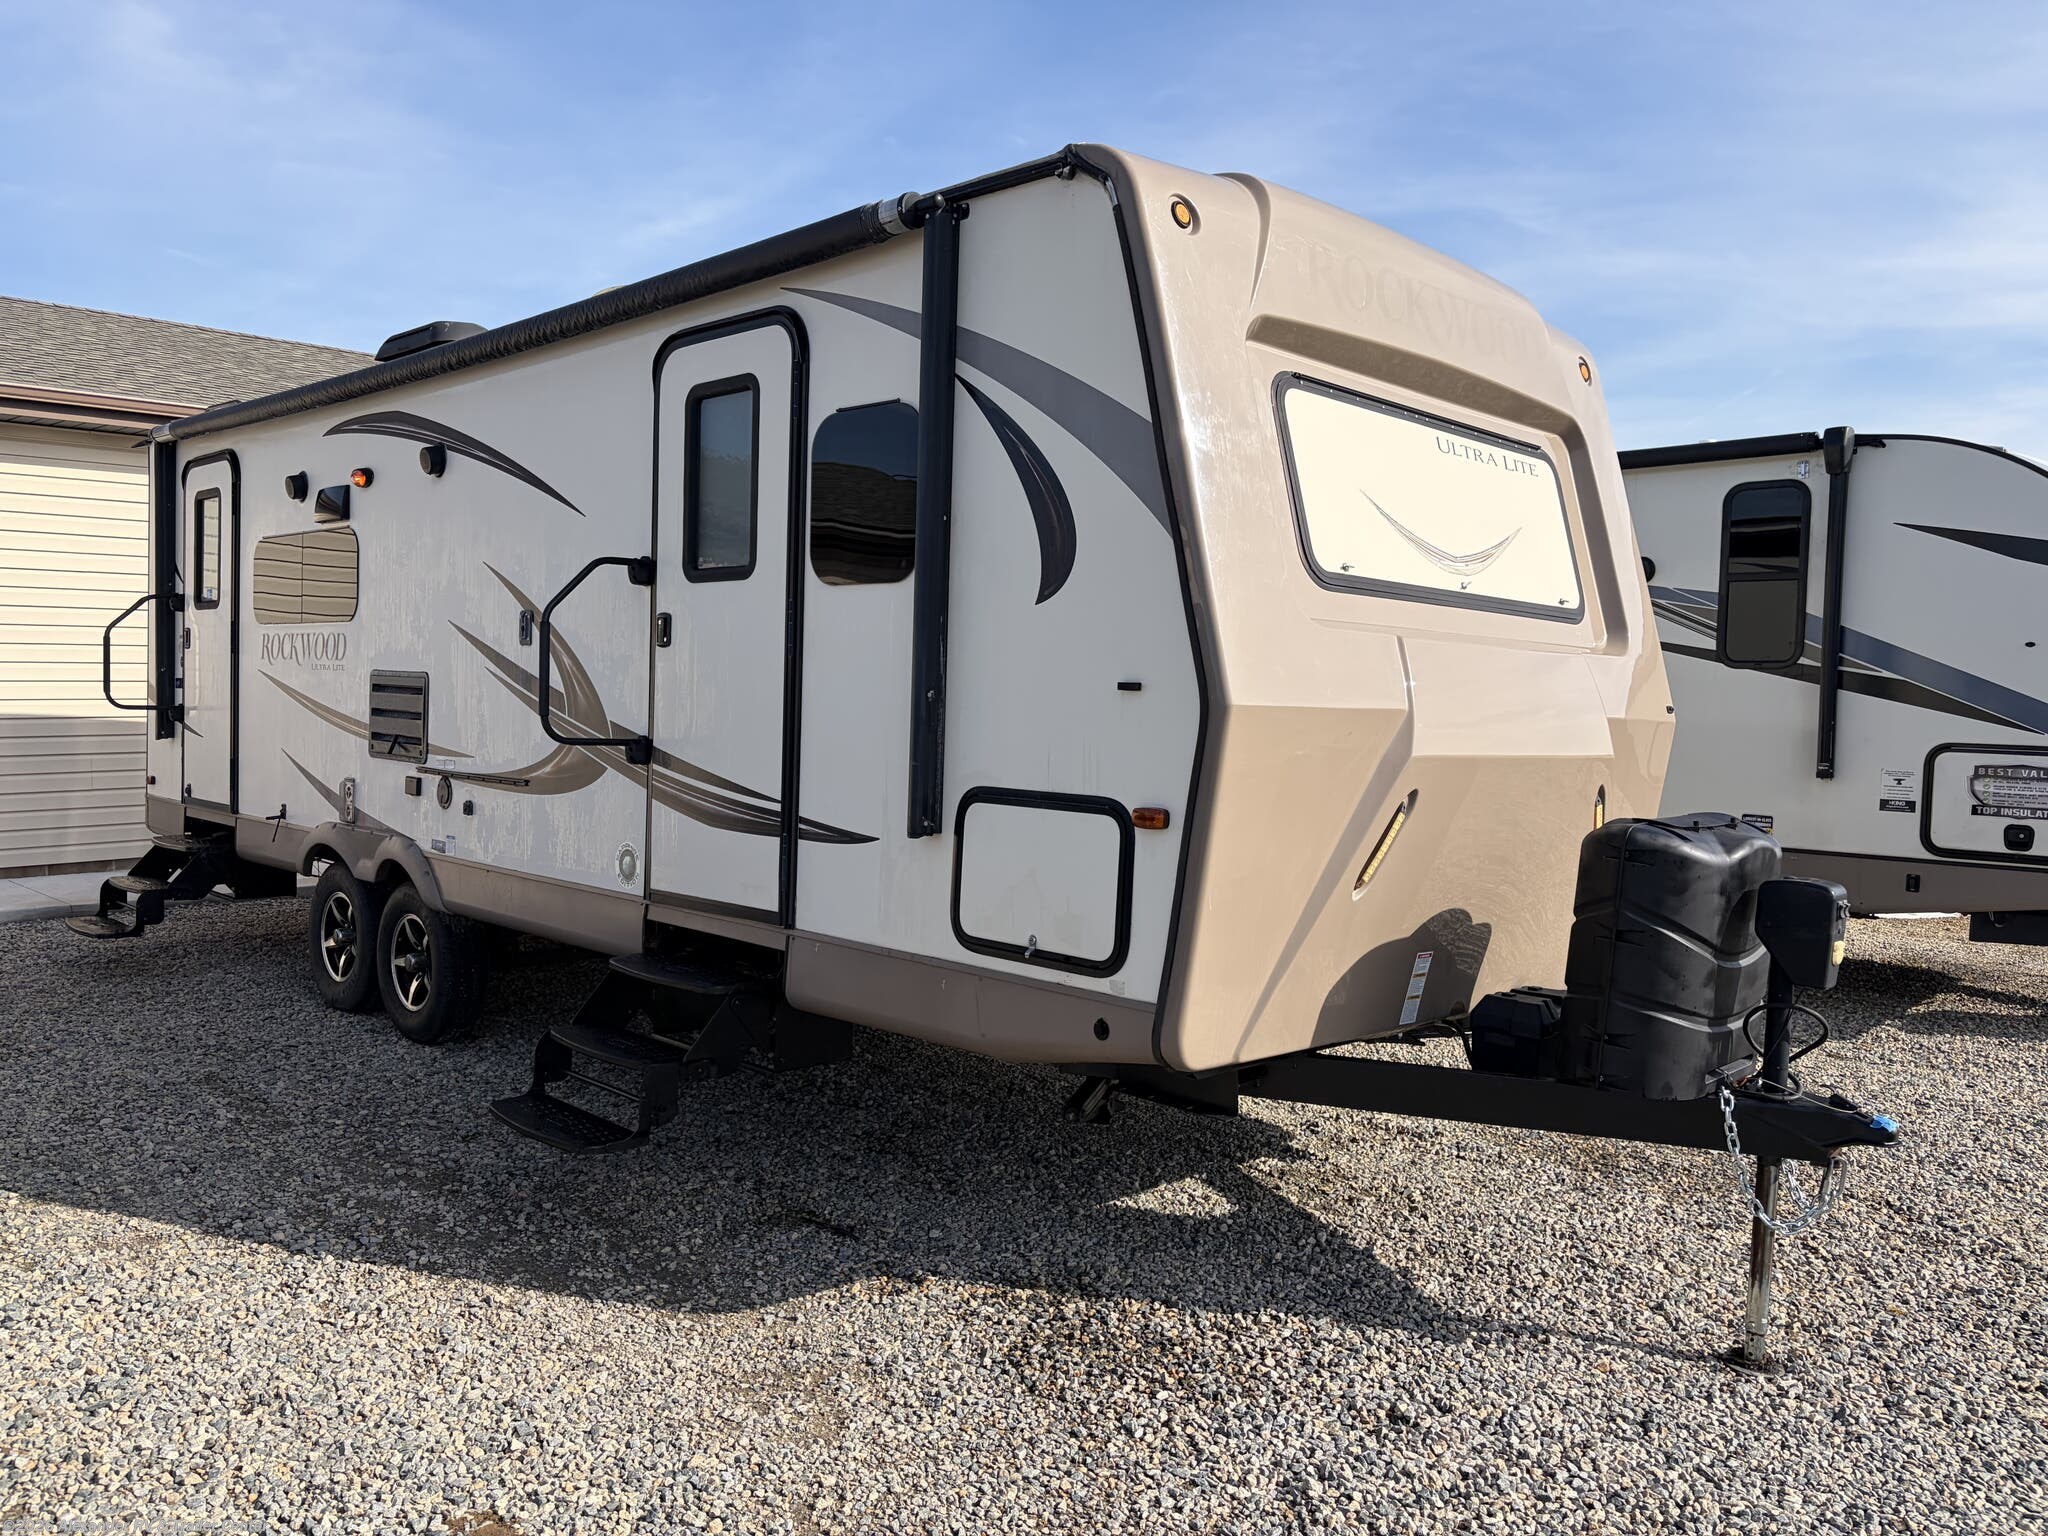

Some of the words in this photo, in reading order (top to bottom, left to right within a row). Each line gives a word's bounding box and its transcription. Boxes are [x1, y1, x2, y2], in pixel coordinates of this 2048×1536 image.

[1436, 436, 1498, 467] ULTRA
[1502, 455, 1539, 477] LITE
[261, 632, 347, 666] ROCKWOOD
[311, 663, 331, 671] ULTRA
[332, 663, 346, 671] LITE
[1978, 767, 2014, 777] BEST
[1976, 806, 1998, 815] TOP
